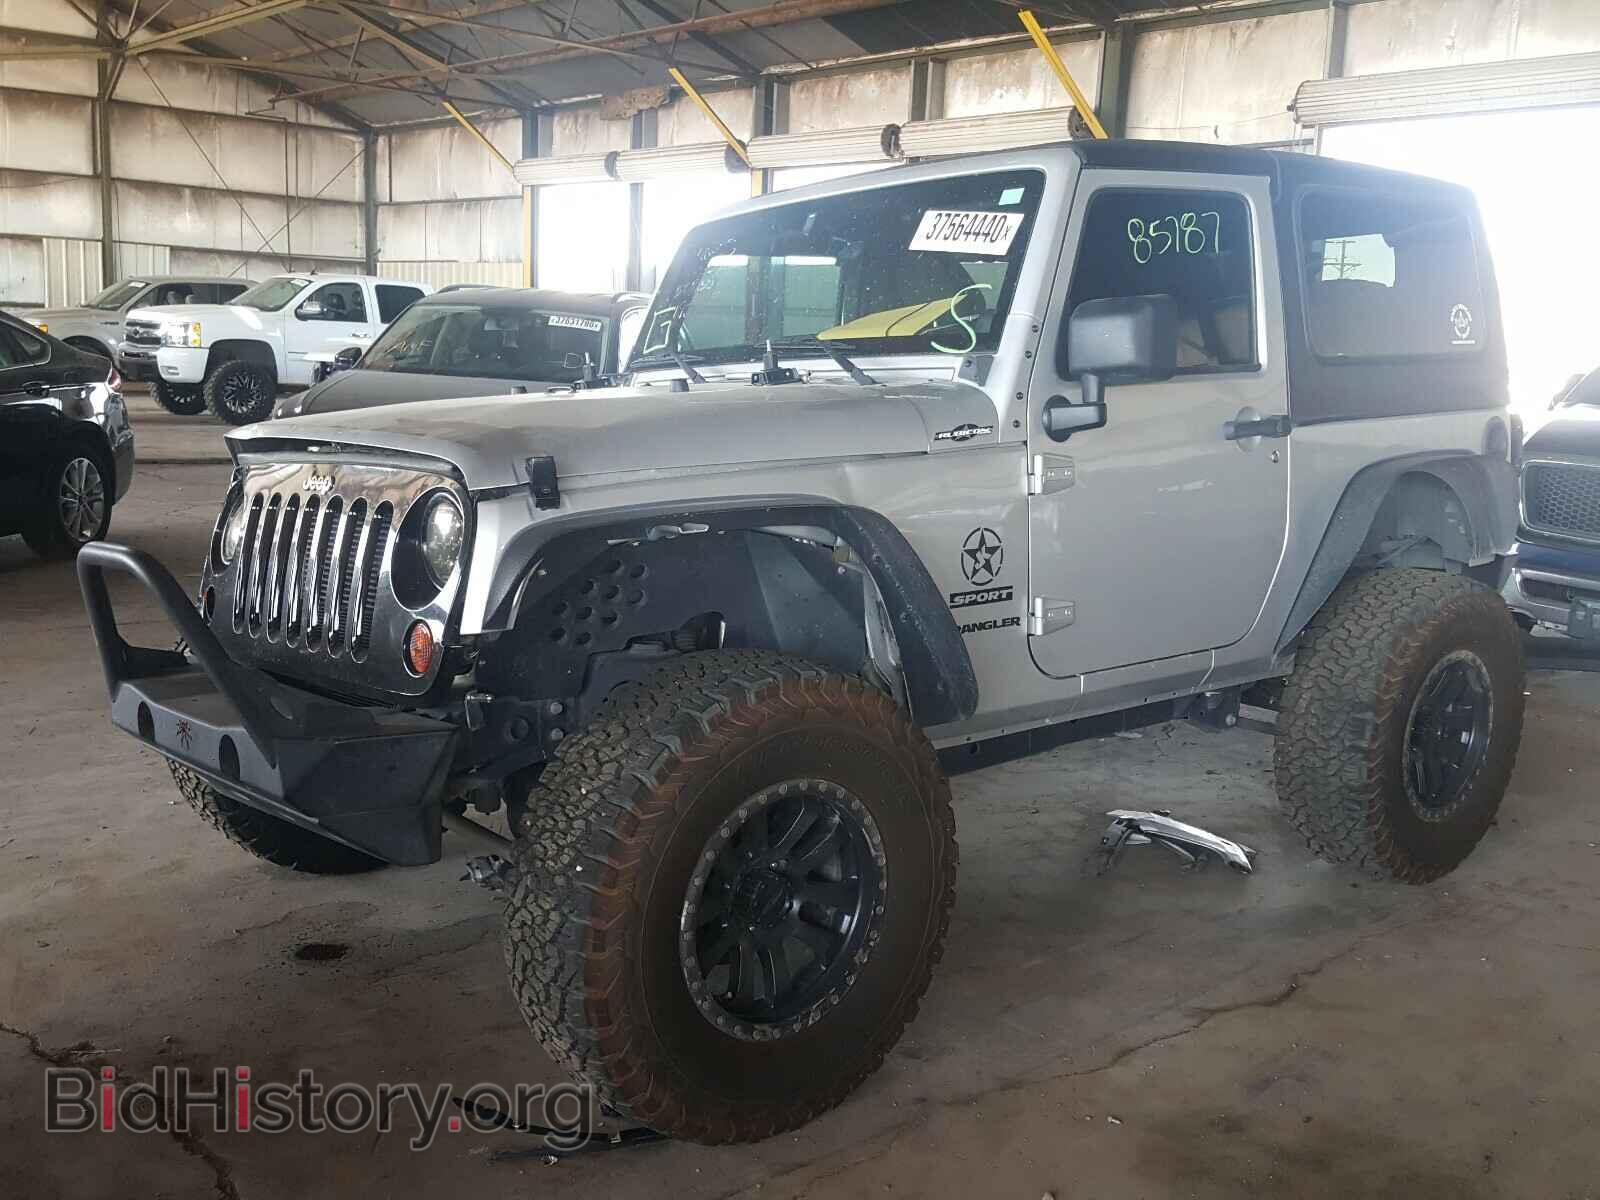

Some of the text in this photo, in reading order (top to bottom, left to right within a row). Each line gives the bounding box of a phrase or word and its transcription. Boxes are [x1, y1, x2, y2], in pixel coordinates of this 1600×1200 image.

[303, 474, 335, 496] Jeep
[951, 588, 1010, 605] SPORT
[958, 616, 1021, 634] ANGLER
